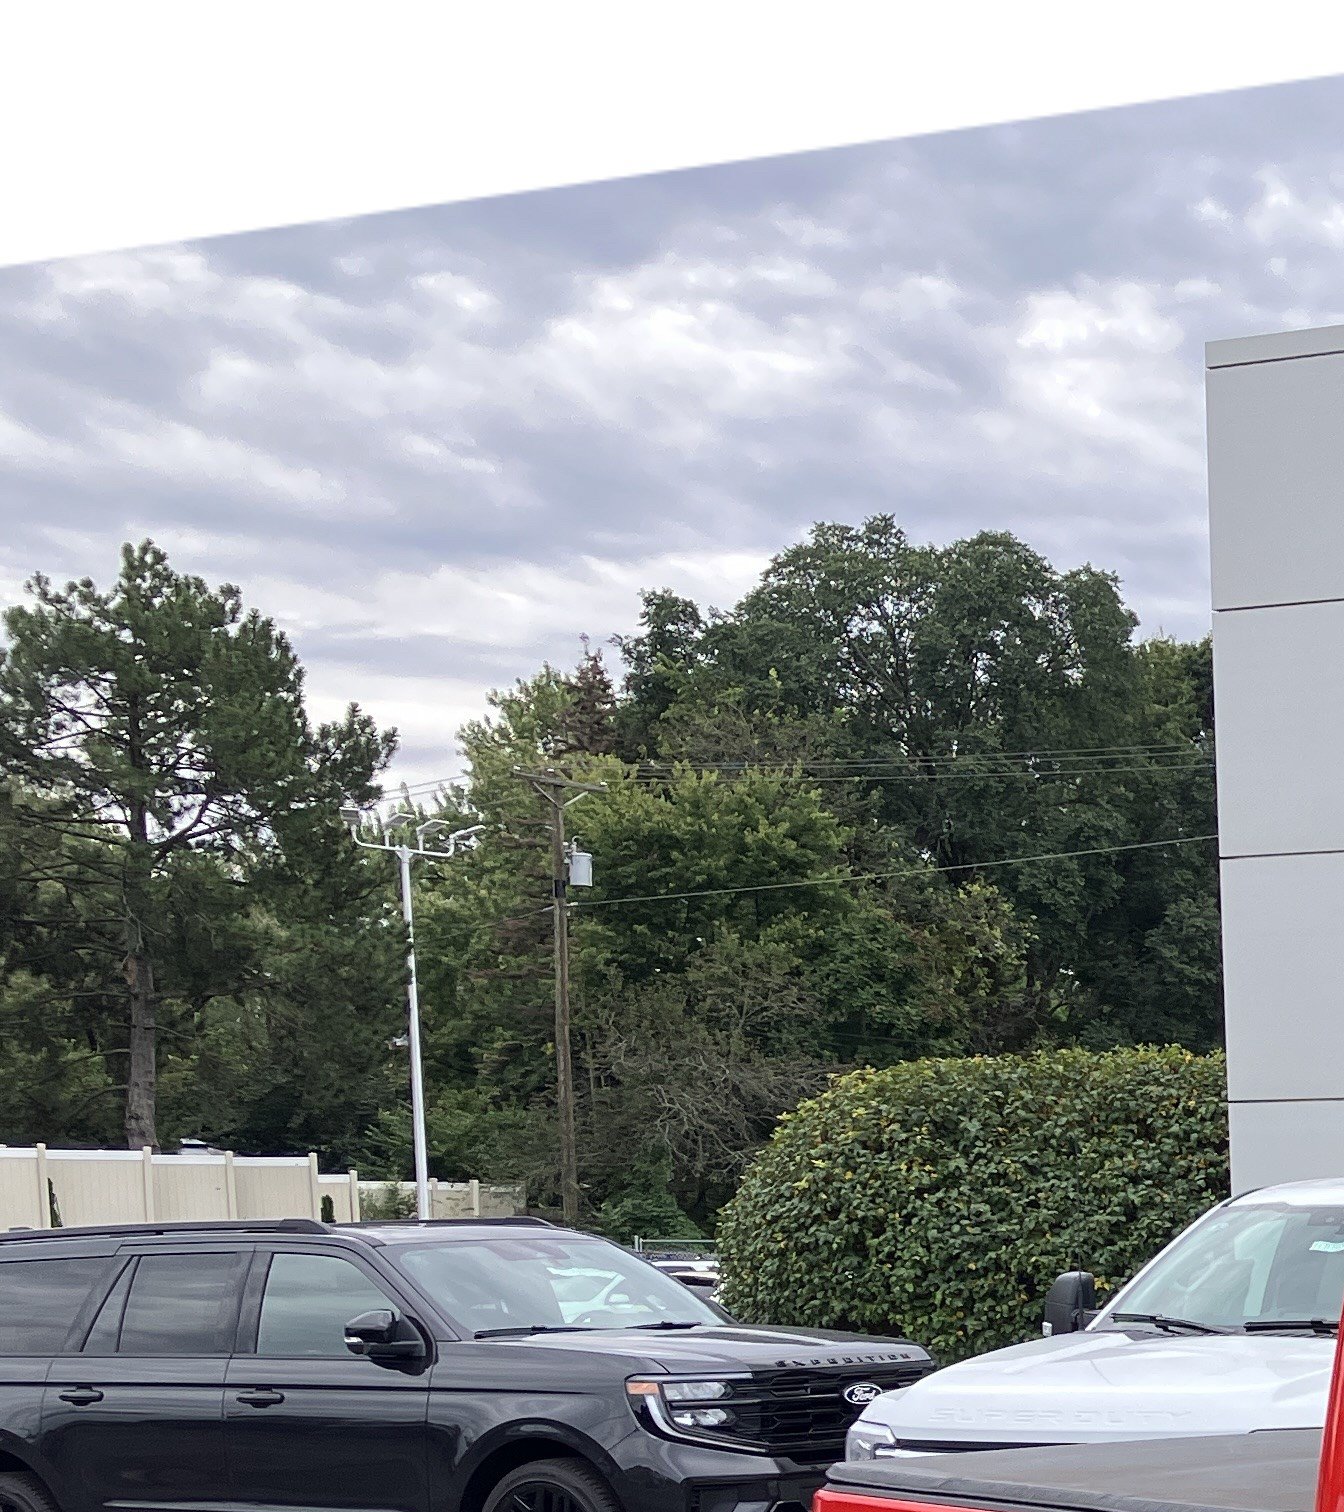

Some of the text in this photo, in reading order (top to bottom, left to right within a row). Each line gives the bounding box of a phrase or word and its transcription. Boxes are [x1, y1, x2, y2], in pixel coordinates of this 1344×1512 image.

[775, 1353, 911, 1368] EXPEDITION
[851, 1386, 878, 1402] Ford
[928, 1407, 1192, 1425] SUPER DUTY
